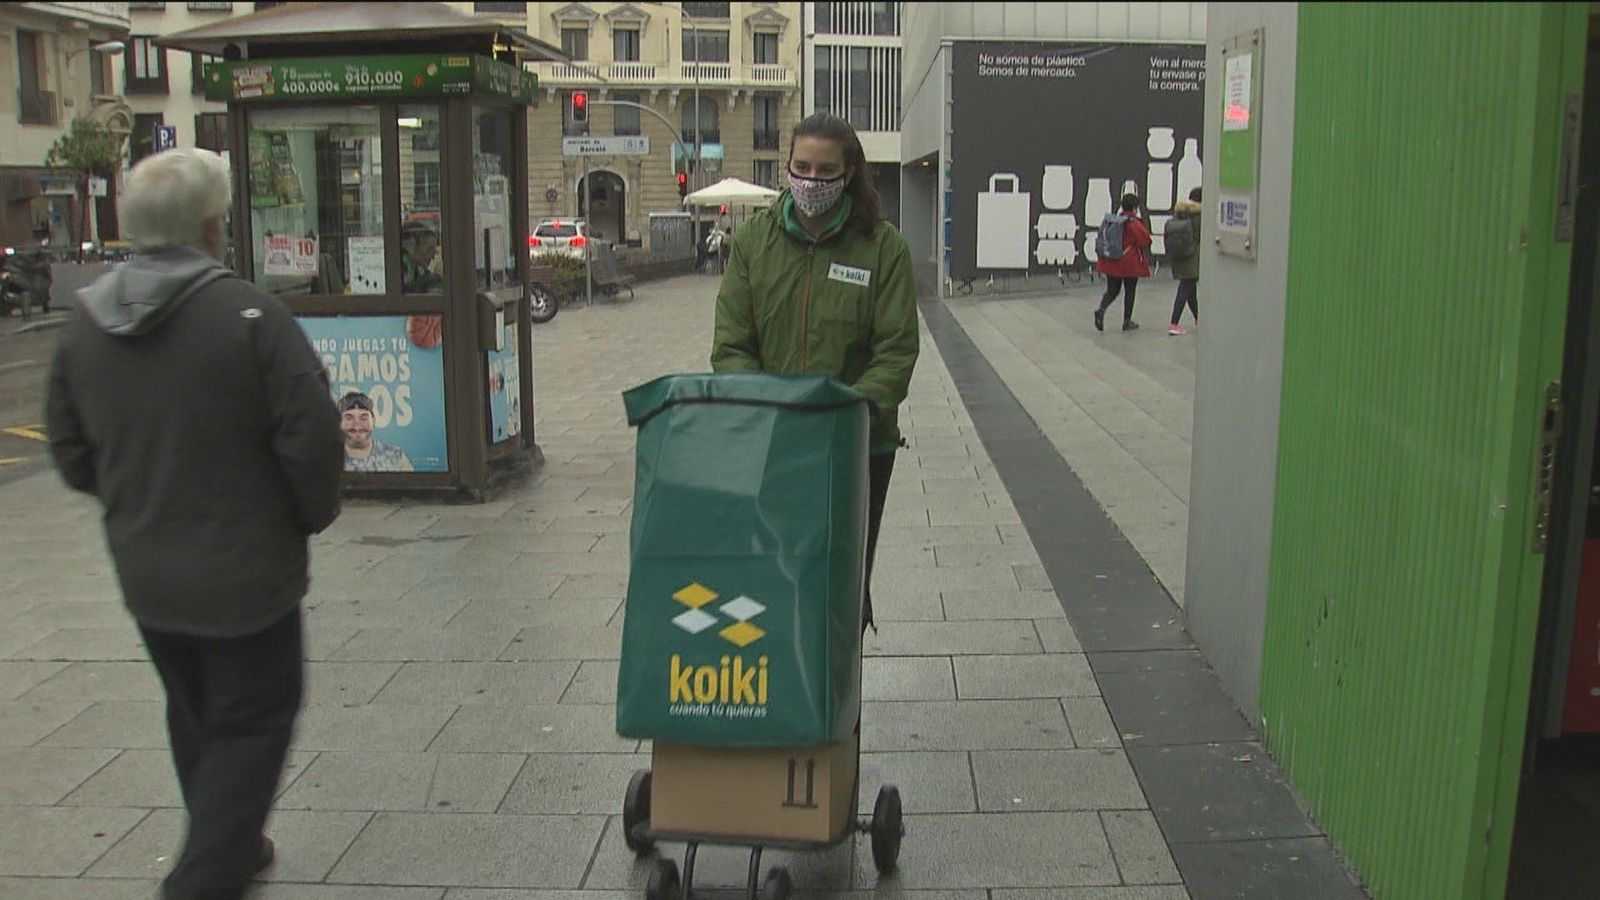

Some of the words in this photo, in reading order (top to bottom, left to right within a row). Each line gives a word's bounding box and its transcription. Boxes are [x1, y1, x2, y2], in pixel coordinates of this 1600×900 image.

[979, 53, 994, 65] No
[996, 55, 1029, 65] somos
[1031, 53, 1044, 66] de
[1150, 56, 1169, 68] Ven
[1170, 56, 1180, 68] al
[345, 70, 403, 85] 910.000
[979, 65, 1014, 76] Somos
[1015, 66, 1029, 76] de
[1031, 66, 1077, 77] mercado.
[1149, 69, 1160, 79] tu
[1161, 70, 1197, 79] envase
[1149, 79, 1158, 90] la
[1160, 81, 1200, 92] compra.
[342, 338, 386, 353] JUEGAS
[669, 654, 768, 705] koiki
[669, 701, 710, 716] cuando
[725, 702, 768, 720] quieras
